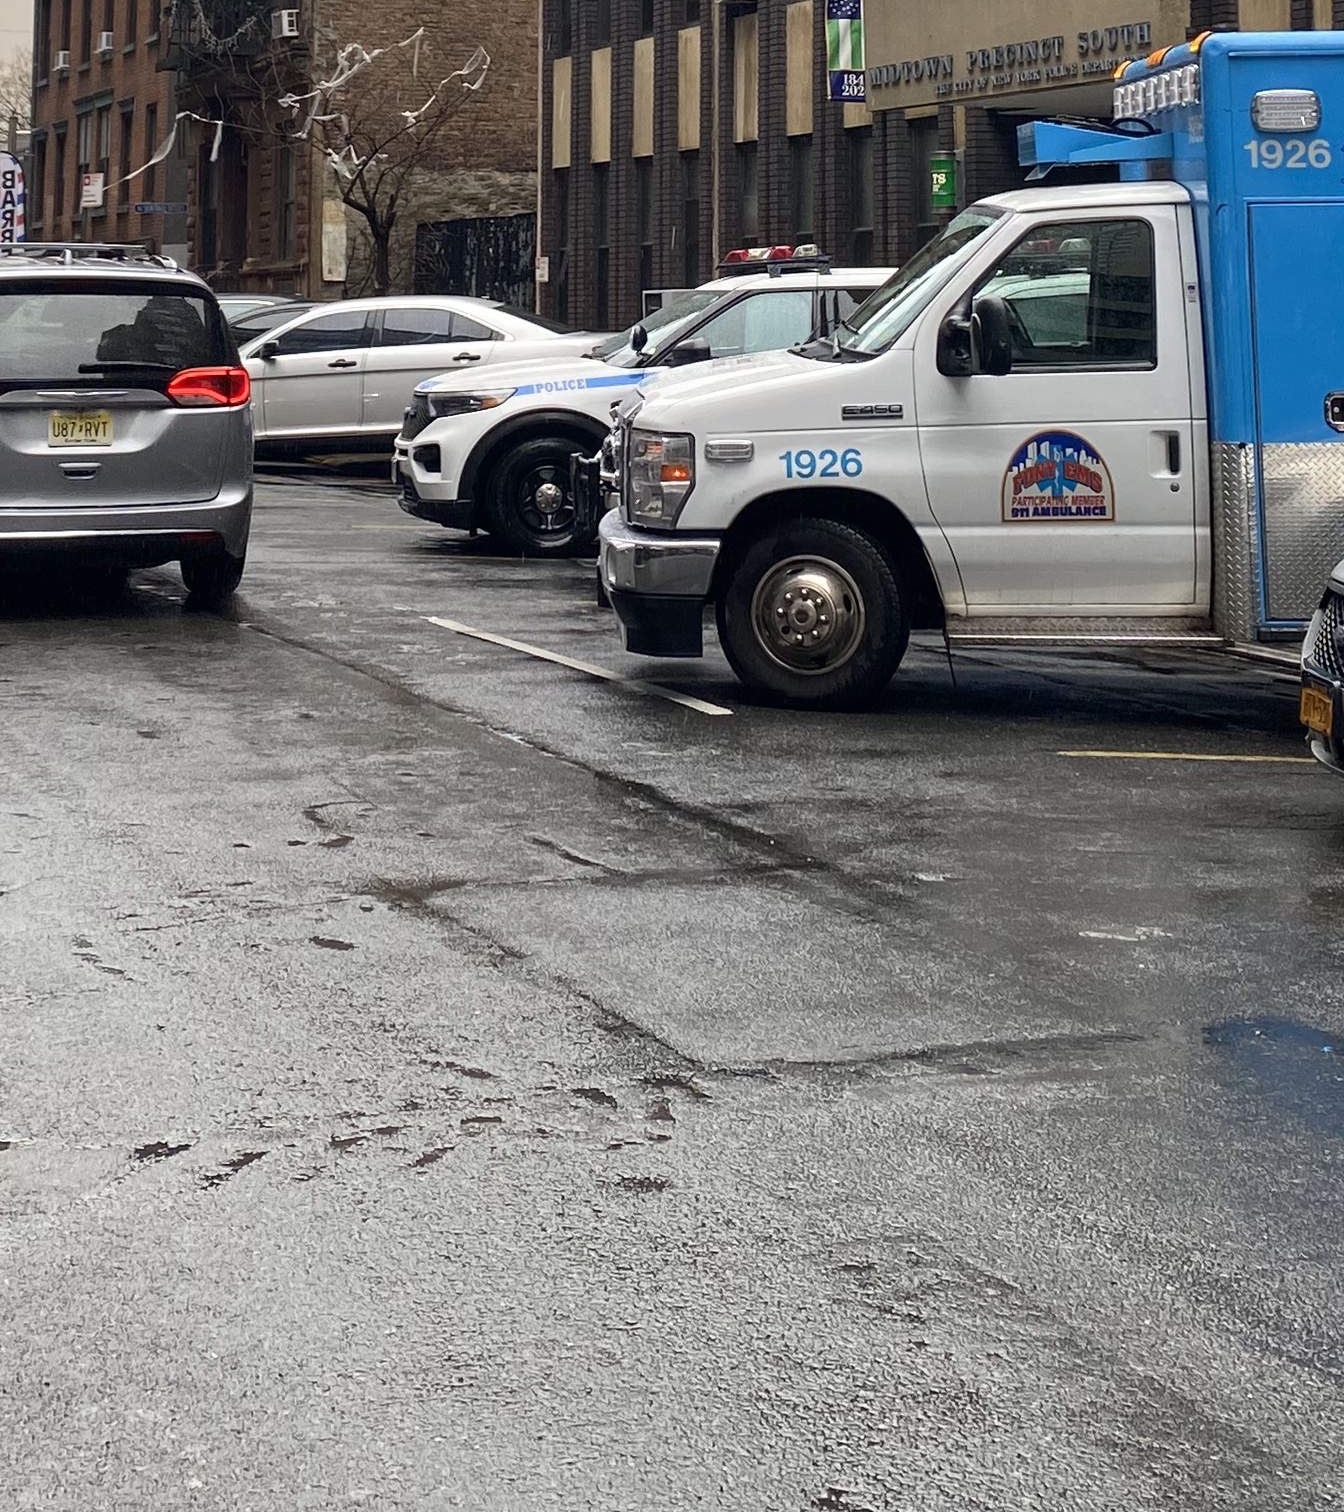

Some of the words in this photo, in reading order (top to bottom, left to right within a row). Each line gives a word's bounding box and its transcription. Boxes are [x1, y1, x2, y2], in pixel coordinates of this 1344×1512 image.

[869, 54, 953, 86] MIDTOWN
[966, 35, 1064, 71] PRECINCT
[1077, 21, 1151, 55] SOUTH
[955, 79, 974, 92] CITY
[991, 72, 1012, 86] NEW
[1015, 68, 1040, 83] YORK
[1044, 62, 1078, 79] POLICE
[1243, 138, 1332, 169] 1926
[536, 378, 585, 393] POLICE
[52, 421, 76, 438] U87
[84, 421, 108, 438] RVT
[779, 448, 863, 479] 1926
[1064, 460, 1103, 494] EMS
[1012, 496, 1069, 507] PARTICIPATING
[1071, 495, 1105, 506] MEMBER
[1032, 506, 1106, 517] AMBULANCE
